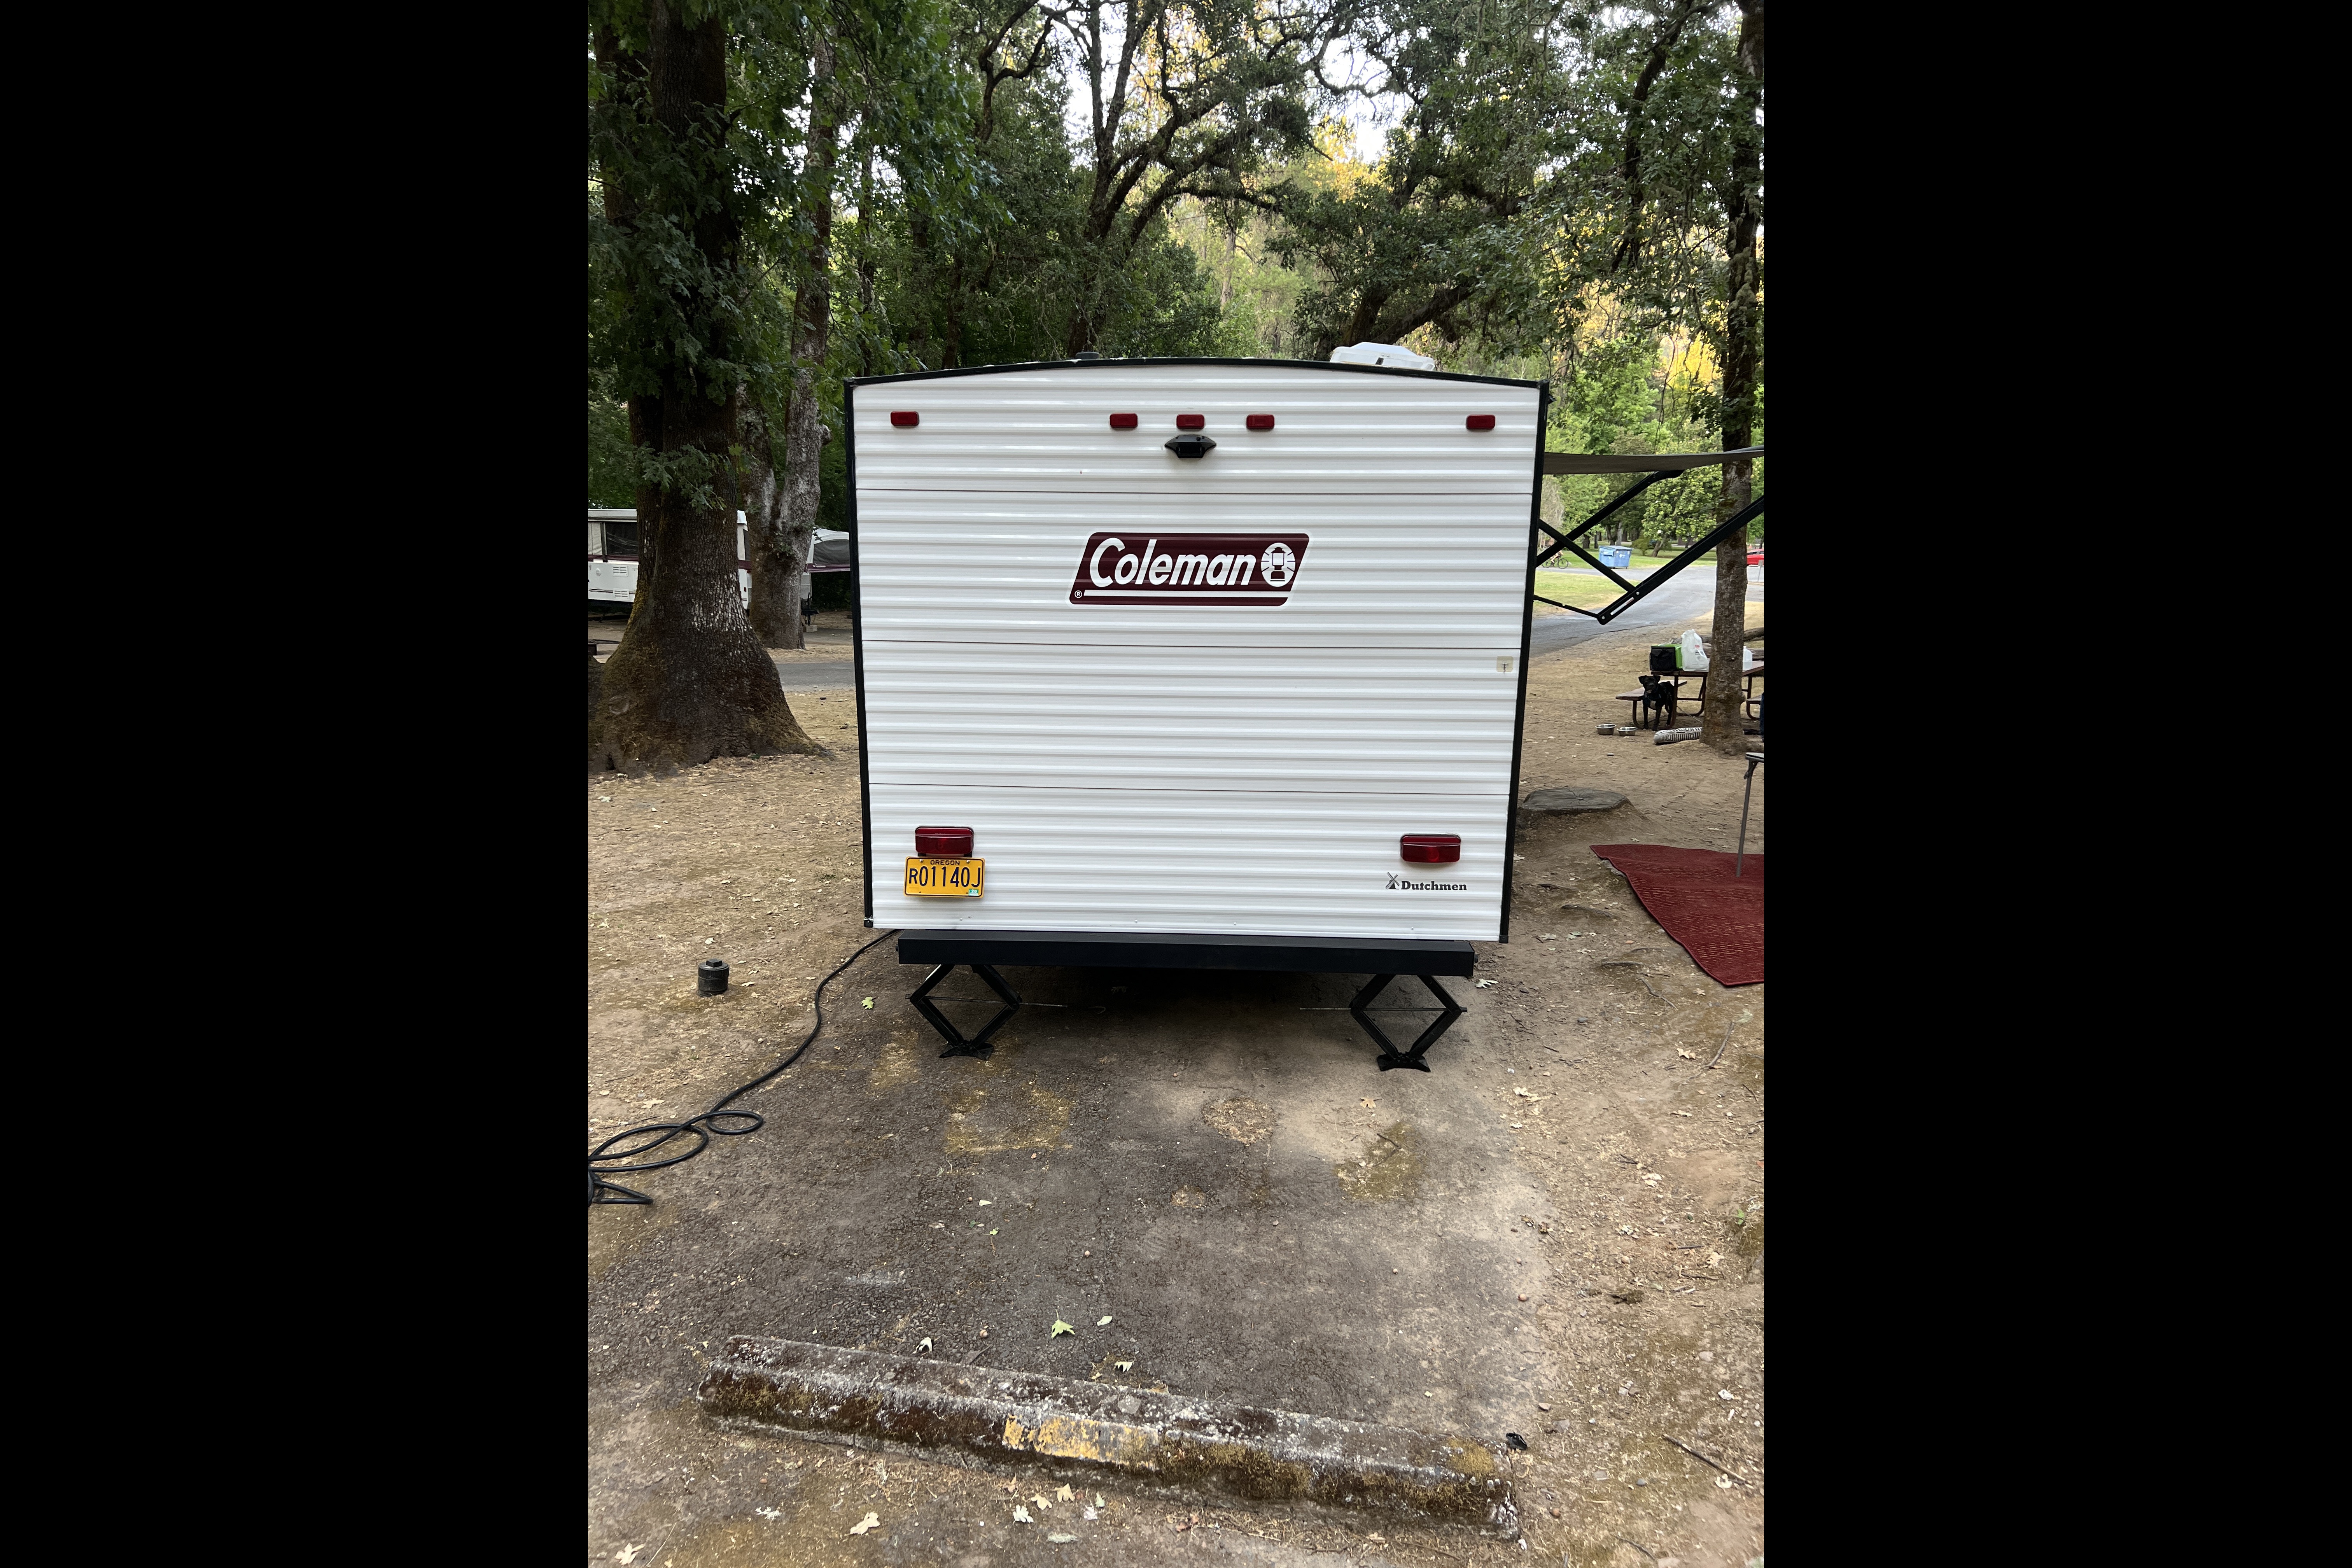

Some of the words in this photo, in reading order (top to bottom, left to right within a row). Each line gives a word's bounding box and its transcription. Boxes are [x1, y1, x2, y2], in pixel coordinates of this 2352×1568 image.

[1090, 537, 1256, 588] Coleman
[909, 866, 981, 887] R01140J
[1401, 880, 1467, 891] Dutchmen
